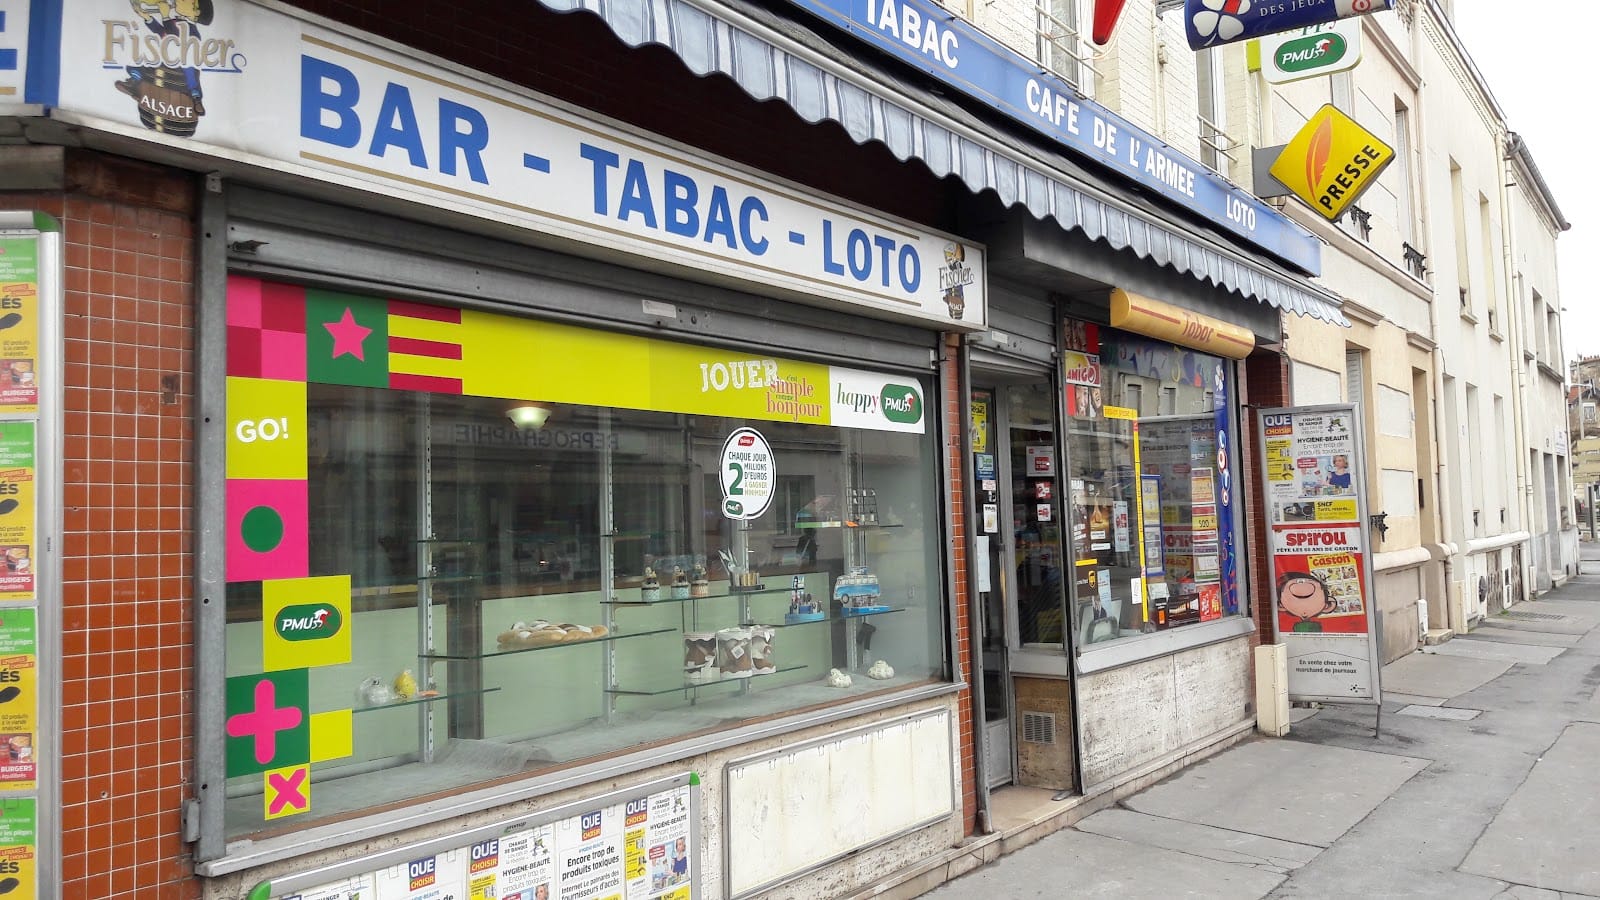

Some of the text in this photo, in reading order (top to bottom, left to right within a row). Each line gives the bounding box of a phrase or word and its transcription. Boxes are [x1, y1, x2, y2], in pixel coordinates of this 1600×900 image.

[1260, 4, 1285, 17] DES
[101, 20, 235, 67] Fischer
[1282, 48, 1314, 64] PMU
[141, 95, 193, 118] ALSACE
[1026, 79, 1080, 136] CAFE
[1093, 116, 1117, 156] DE
[301, 54, 489, 185] BAR
[580, 143, 769, 256] TABAC
[823, 219, 921, 294] LOTO
[1320, 142, 1379, 211] PRESSE
[1226, 200, 1256, 232] LOTO
[939, 265, 971, 289] Fischer
[700, 359, 780, 392] JOUER
[1066, 363, 1097, 383] AMIGO
[770, 378, 814, 401] simple
[836, 383, 879, 414] happy
[766, 391, 823, 421] bonjour
[884, 397, 905, 412] PMU
[235, 417, 289, 443] GO!
[1265, 415, 1292, 426] QUE
[728, 452, 767, 462] CHAQUE JOUR
[743, 463, 767, 471] MILLIONS
[728, 462, 744, 495] 2
[744, 471, 767, 481] D'EUROS
[281, 618, 314, 632] PMU
[627, 799, 647, 815] QUE
[582, 813, 601, 829] QUE
[626, 813, 647, 825] CHOISIR
[583, 829, 601, 840] CHOISIR
[472, 840, 498, 860] QUE
[567, 853, 591, 867] Encore
[592, 849, 605, 860] trop
[606, 845, 615, 855] de
[410, 859, 434, 878] QUE
[471, 858, 498, 871] CHOISIR
[562, 855, 620, 882] produits toxiques
[411, 875, 434, 889] CHOISIR
[561, 882, 583, 894] Internet
[583, 880, 589, 888] Le
[611, 870, 620, 878] des
[561, 878, 620, 900] fournisseurs d'accès
